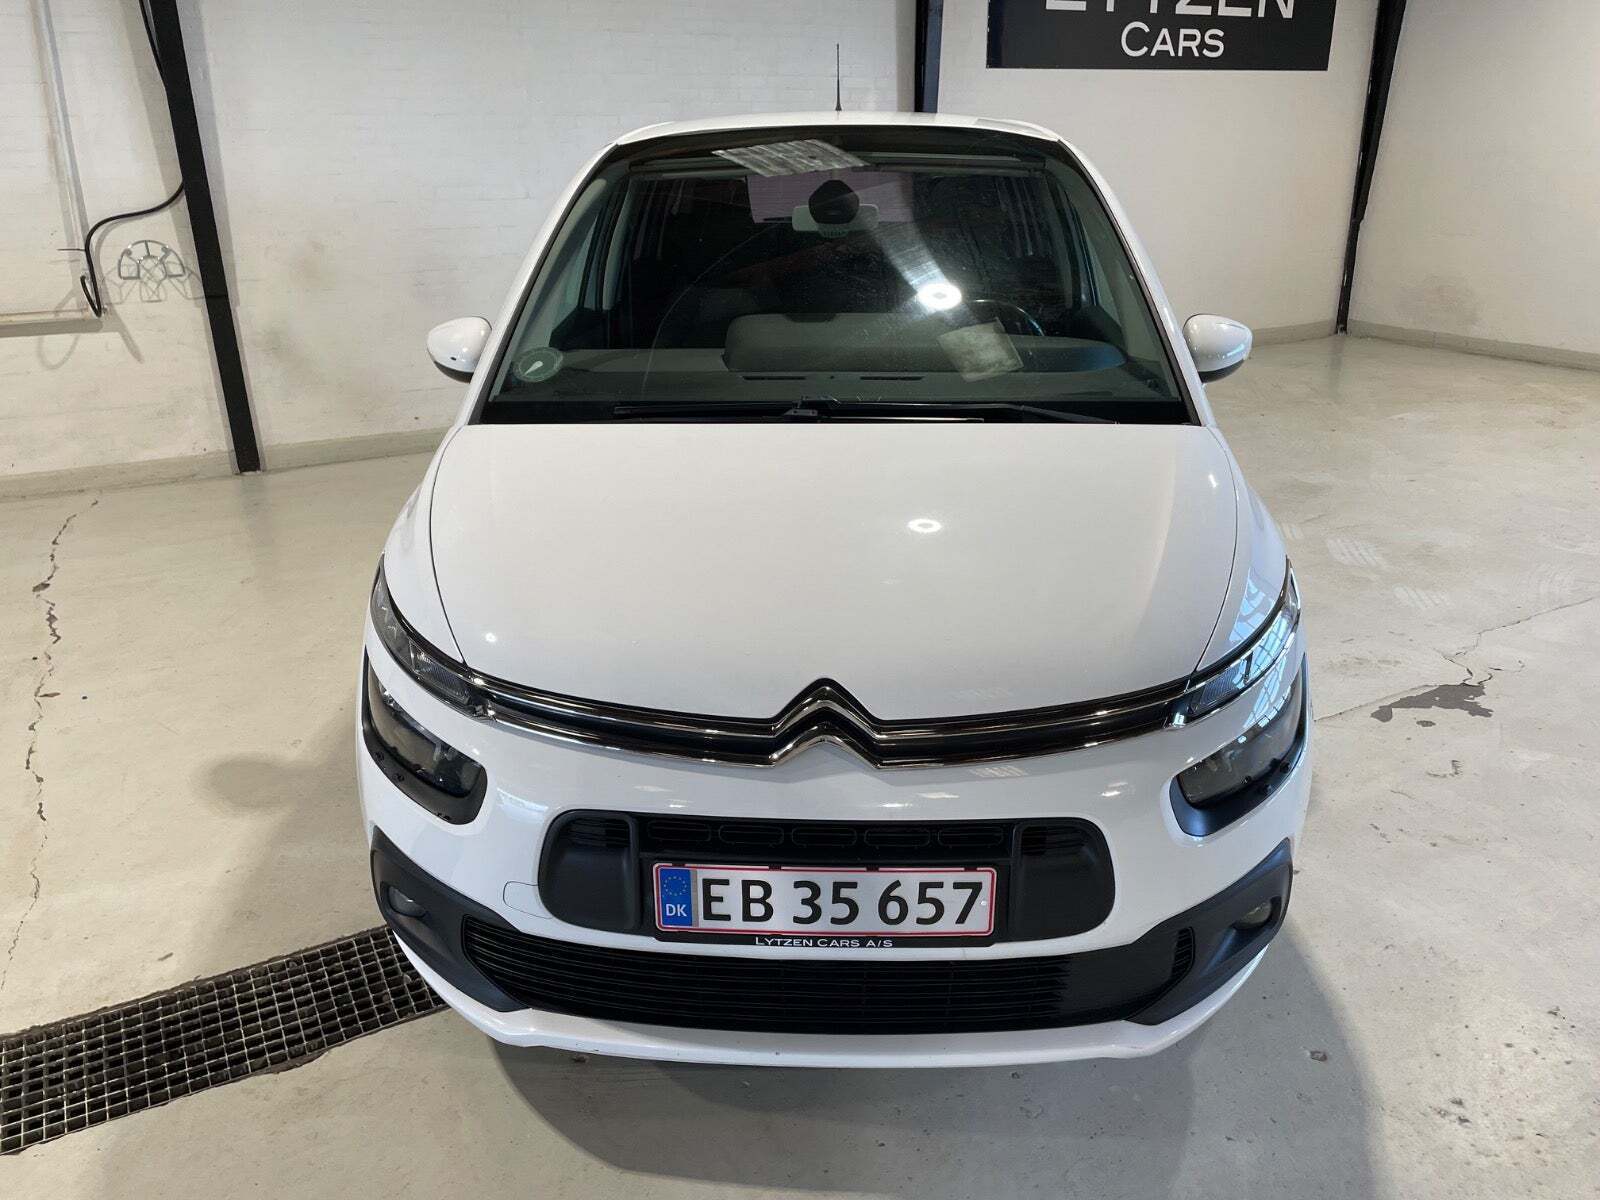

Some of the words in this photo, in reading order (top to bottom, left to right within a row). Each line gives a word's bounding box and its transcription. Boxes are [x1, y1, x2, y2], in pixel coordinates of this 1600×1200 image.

[1120, 21, 1225, 58] CARS
[665, 903, 687, 917] DK
[702, 878, 774, 922] EB
[792, 880, 859, 926] 35
[877, 879, 984, 926] 657
[755, 936, 813, 947] LYTZEN
[817, 938, 860, 947] CARS
[865, 939, 893, 948] A/S
